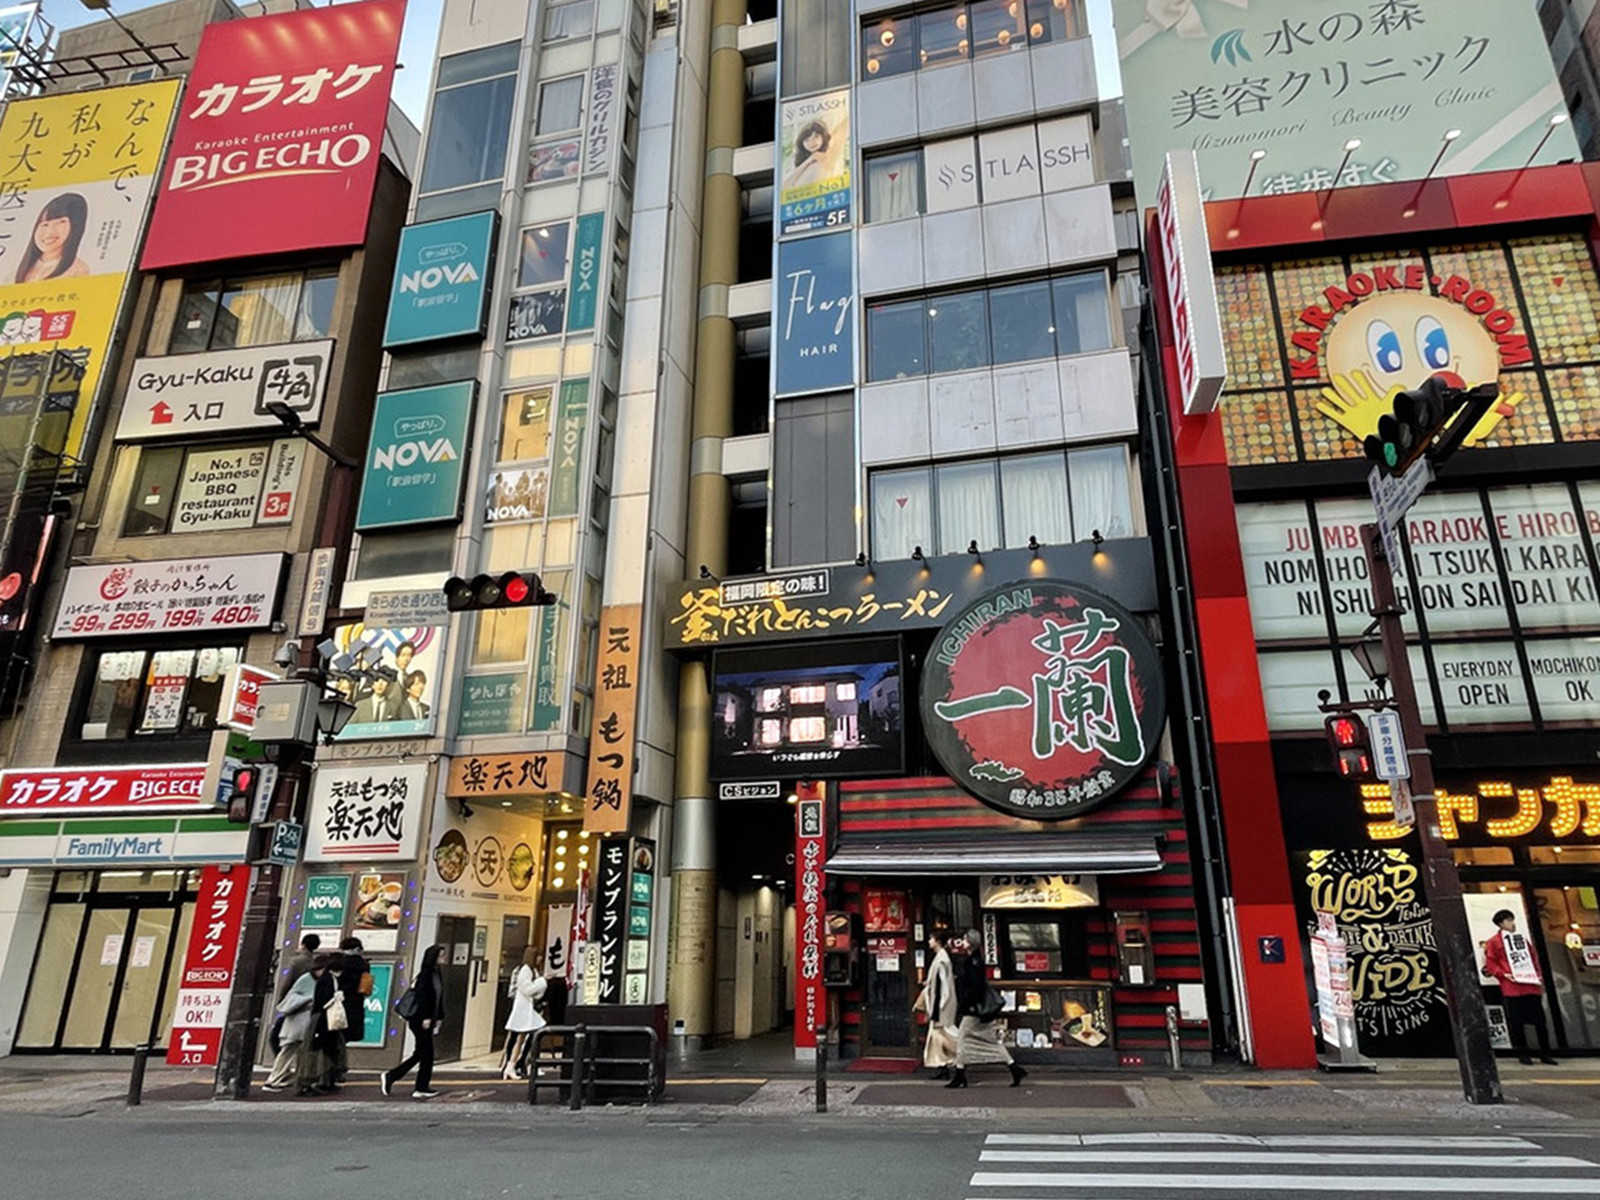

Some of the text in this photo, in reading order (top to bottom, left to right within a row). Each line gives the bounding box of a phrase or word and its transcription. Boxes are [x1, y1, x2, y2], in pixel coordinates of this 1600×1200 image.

[1264, 0, 1424, 57] 水の森
[189, 63, 383, 120] カラオケ
[1171, 35, 1491, 130] 美容クリニック
[1331, 103, 1412, 127] Beauty
[1434, 85, 1497, 108] Clinic
[60, 104, 102, 171] 私が
[195, 121, 355, 151] Karaoke Entertainment
[109, 98, 155, 203] なんで、
[168, 134, 371, 191] BIG ECHO
[961, 143, 1090, 183] STLASSH
[826, 209, 847, 226] 5F
[400, 262, 479, 294] NOVA
[577, 248, 594, 291] NOVA
[785, 269, 853, 340] Flag
[508, 325, 547, 339] NOVA
[800, 343, 839, 358] HAIR
[137, 365, 254, 393] Gyu-Kaku
[183, 402, 224, 423] 入口
[373, 438, 458, 471] NOVA
[561, 417, 579, 468] NOVA
[189, 468, 260, 484] Japanese
[209, 457, 242, 472] No.1
[284, 456, 297, 477] This
[204, 483, 238, 496] BBQ
[180, 495, 256, 512] restaurant
[180, 508, 252, 525] Gyu-Kaku
[265, 496, 288, 514] 3F
[487, 505, 529, 520] NOVA
[1286, 525, 1366, 552] JUMB
[1392, 516, 1511, 545] ARAOKE
[1521, 541, 1600, 571] KARA
[133, 573, 239, 595] 餃子のかっちゃん
[671, 588, 953, 643] 釜だれとんこつラーメン
[937, 587, 1033, 667] ICHIRAN
[1442, 659, 1514, 679] EVERYDAY
[1530, 655, 1600, 676] MOCHIKO
[469, 683, 521, 700] なんぼや
[934, 608, 1146, 766] 一蘭
[1457, 684, 1511, 705] OPEN
[1565, 680, 1594, 702] OK
[592, 627, 633, 812] 元祖もつ鍋
[462, 756, 548, 792] 楽天地
[7, 777, 118, 804] カラオケ
[128, 779, 169, 801] BIG
[330, 776, 408, 802] 元祖もつ鍋
[279, 824, 288, 841] P
[325, 799, 404, 841] 楽天地
[67, 837, 162, 857] FamilyMart
[480, 850, 498, 876] 天
[308, 896, 342, 909] NOVA
[1306, 864, 1418, 921] WORLD
[202, 878, 234, 962] カラオケ
[599, 846, 624, 998] モンブランビル
[1387, 922, 1437, 949] DRINK
[1504, 934, 1526, 951] 1番
[181, 995, 222, 1007] 持ち込み
[185, 1009, 214, 1024] OK!!
[1395, 1009, 1430, 1035] SING
[182, 1053, 203, 1064] 入口
